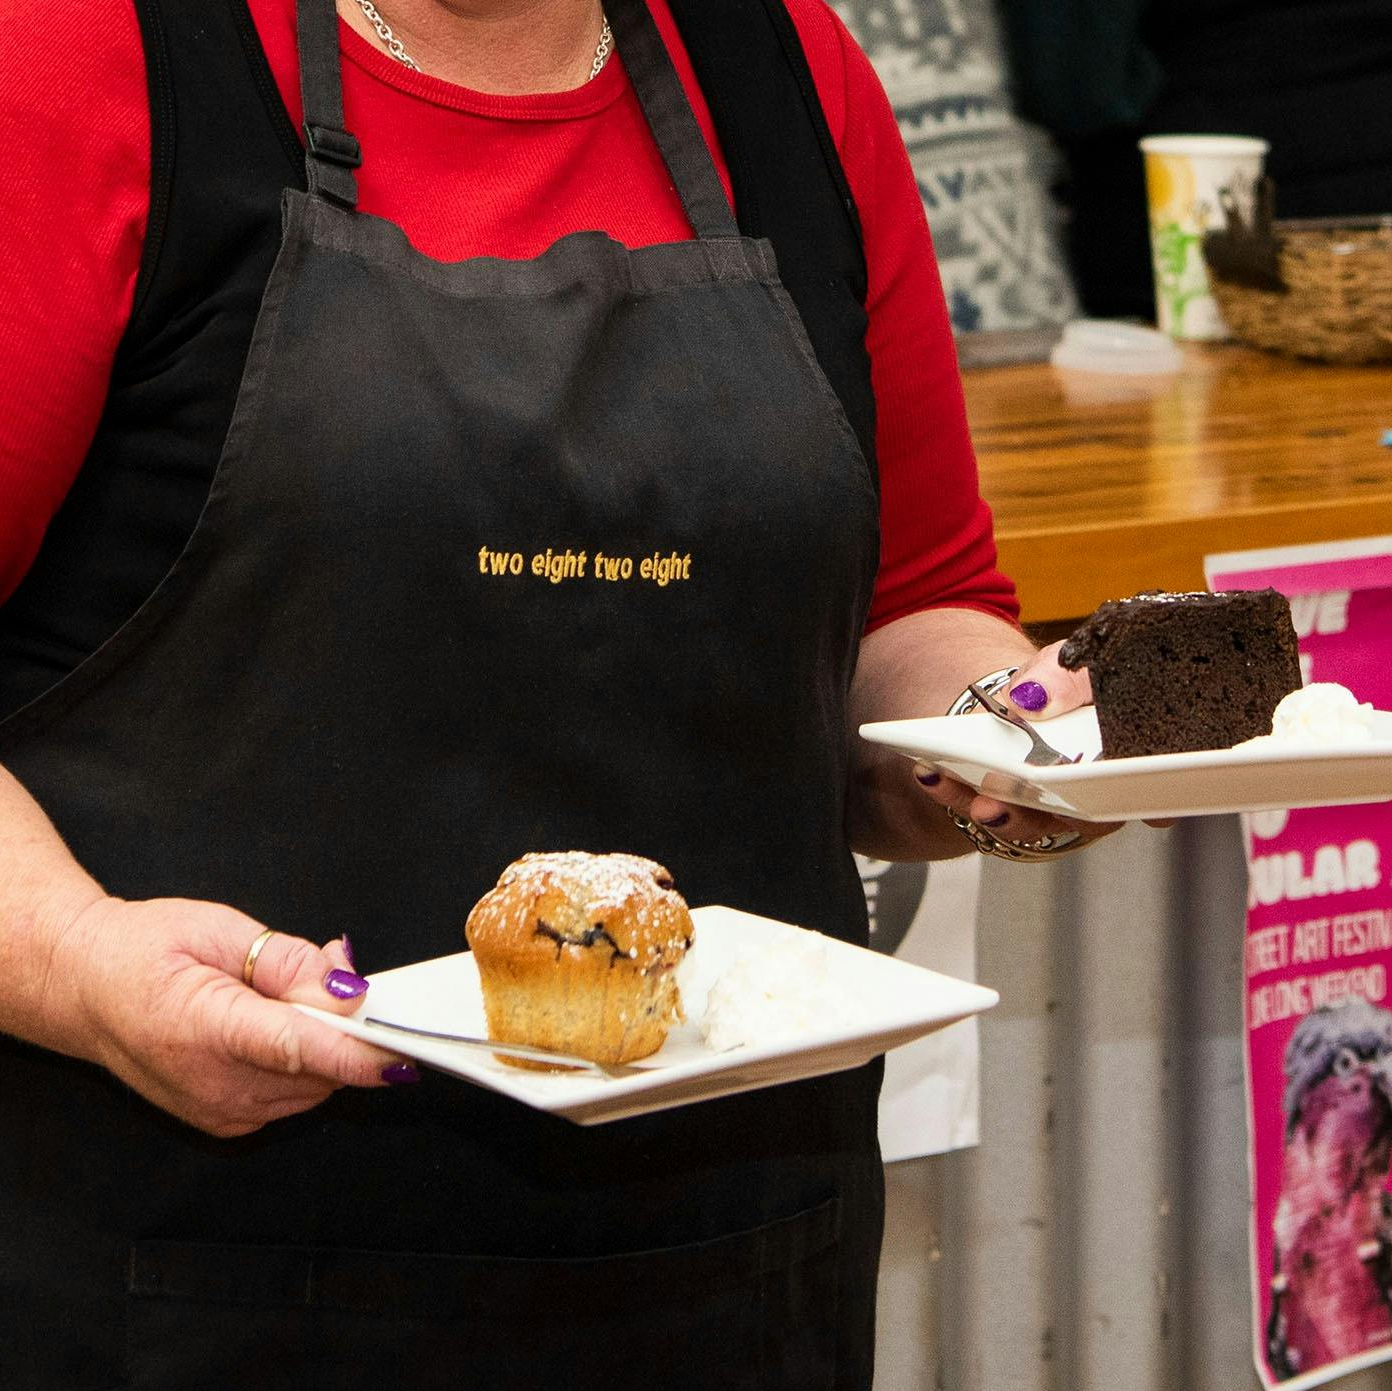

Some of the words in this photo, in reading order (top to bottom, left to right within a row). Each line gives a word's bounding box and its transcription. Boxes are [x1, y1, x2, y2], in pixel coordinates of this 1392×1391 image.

[478, 545, 524, 577] two
[531, 548, 587, 585] eight
[594, 551, 634, 582] two
[640, 551, 692, 587] eight
[1249, 838, 1382, 908] ULAR
